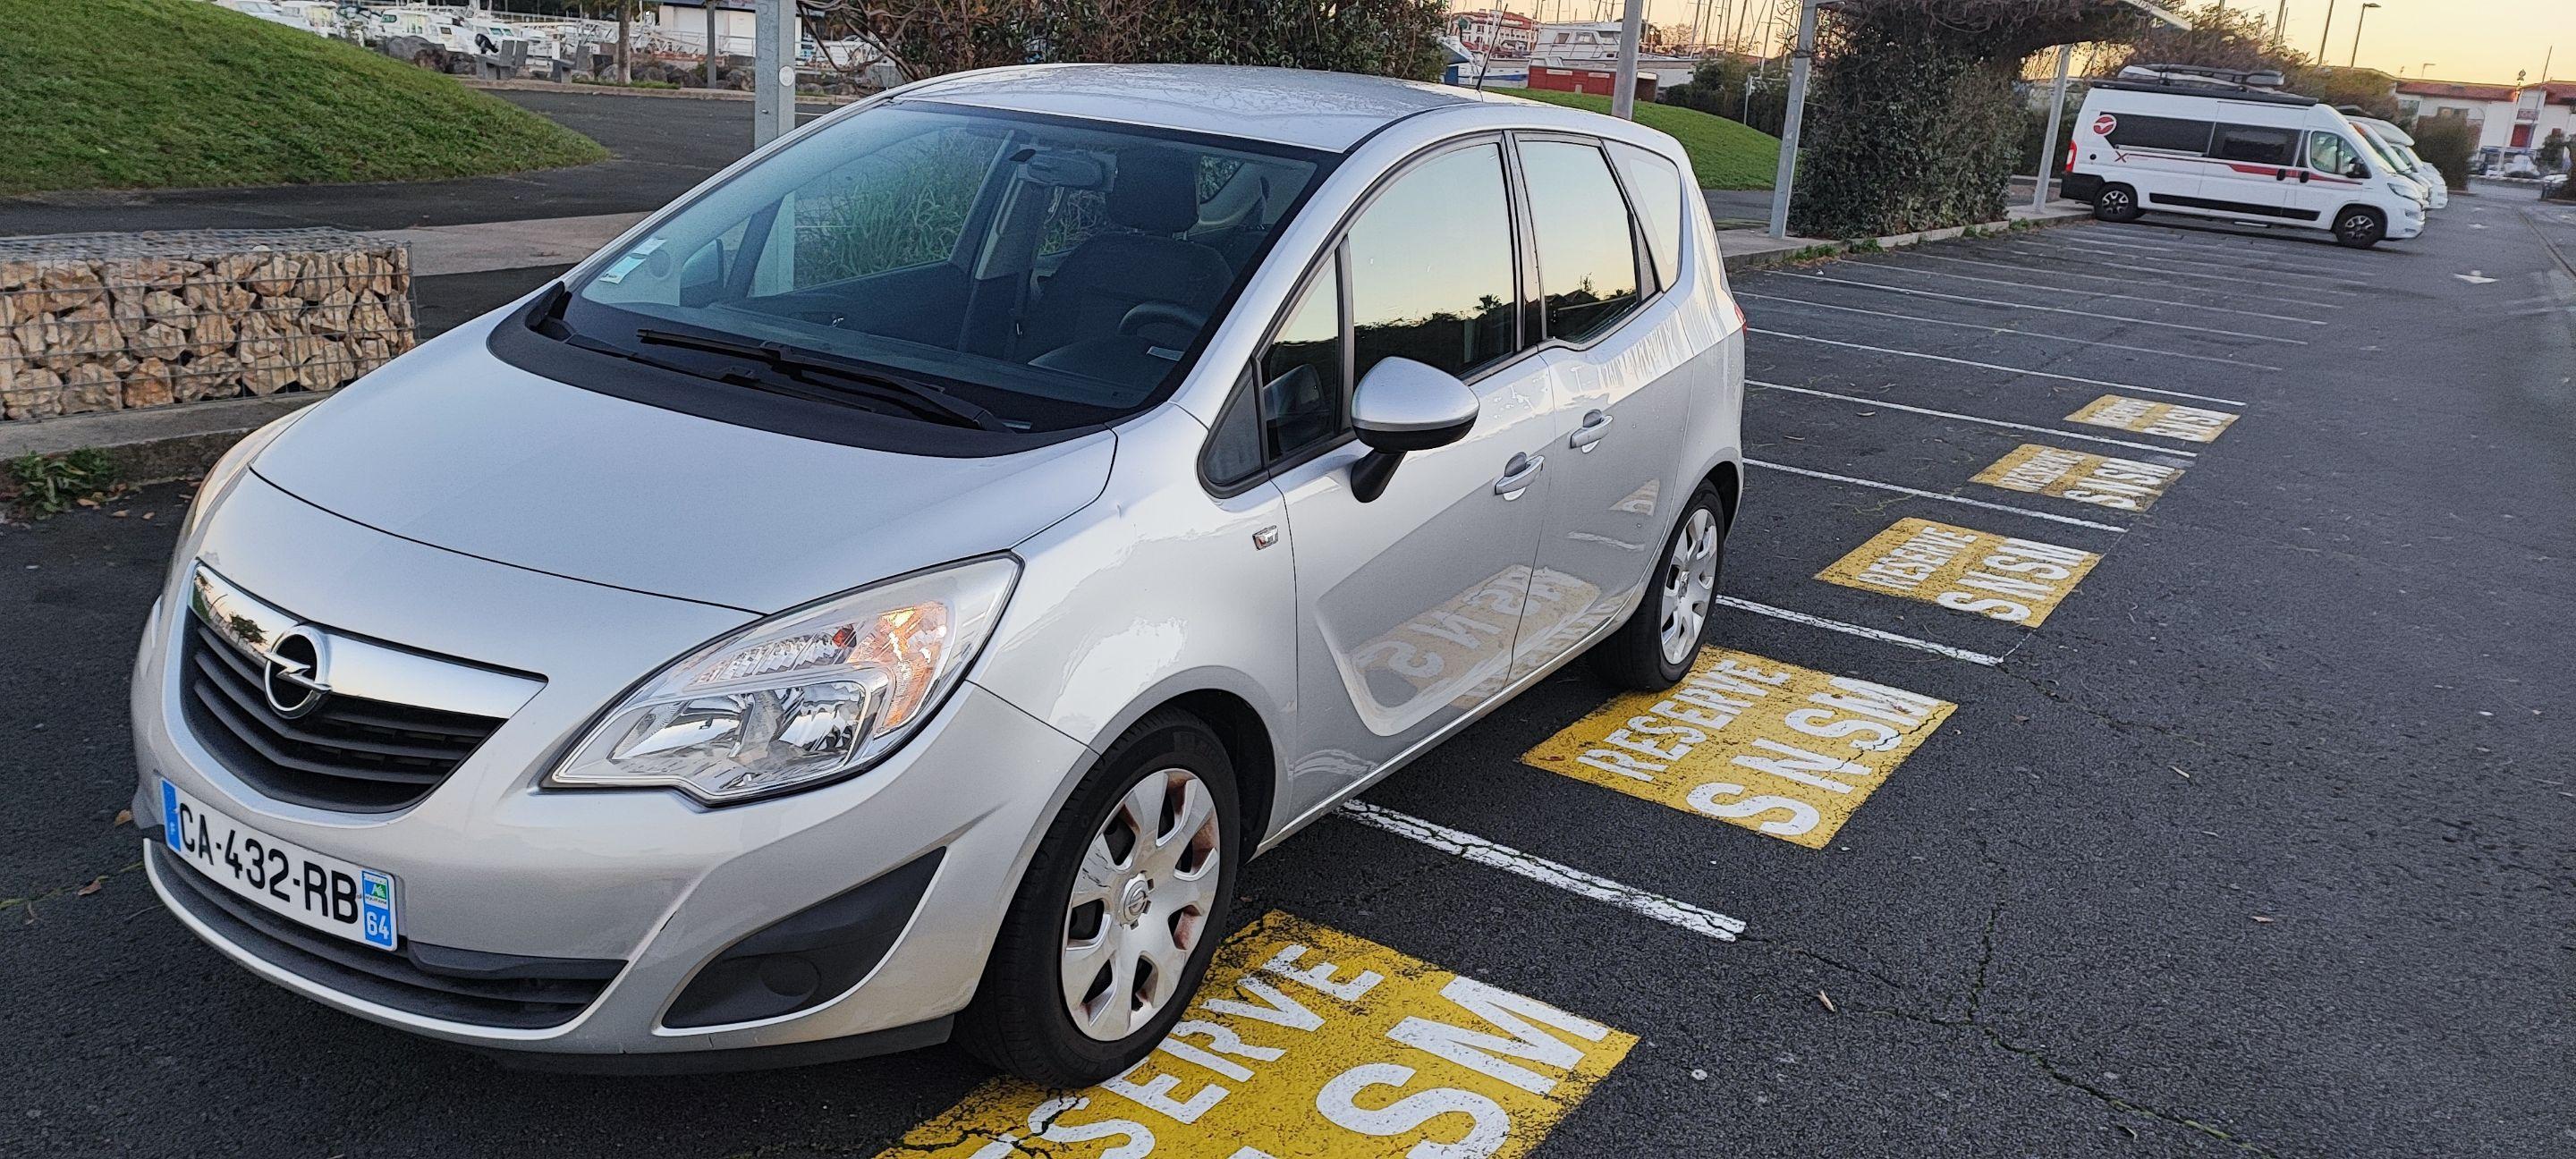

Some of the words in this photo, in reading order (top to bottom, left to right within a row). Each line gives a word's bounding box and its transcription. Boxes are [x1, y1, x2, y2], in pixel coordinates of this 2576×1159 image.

[1856, 527, 1978, 590] RESERVE
[1937, 537, 2090, 621] SNSM
[1576, 659, 1790, 782] RESERVE
[1686, 676, 1946, 835] SNSM
[179, 802, 359, 925] CA-432-RB
[367, 911, 390, 940] 64
[970, 944, 1385, 1159] SERVE
